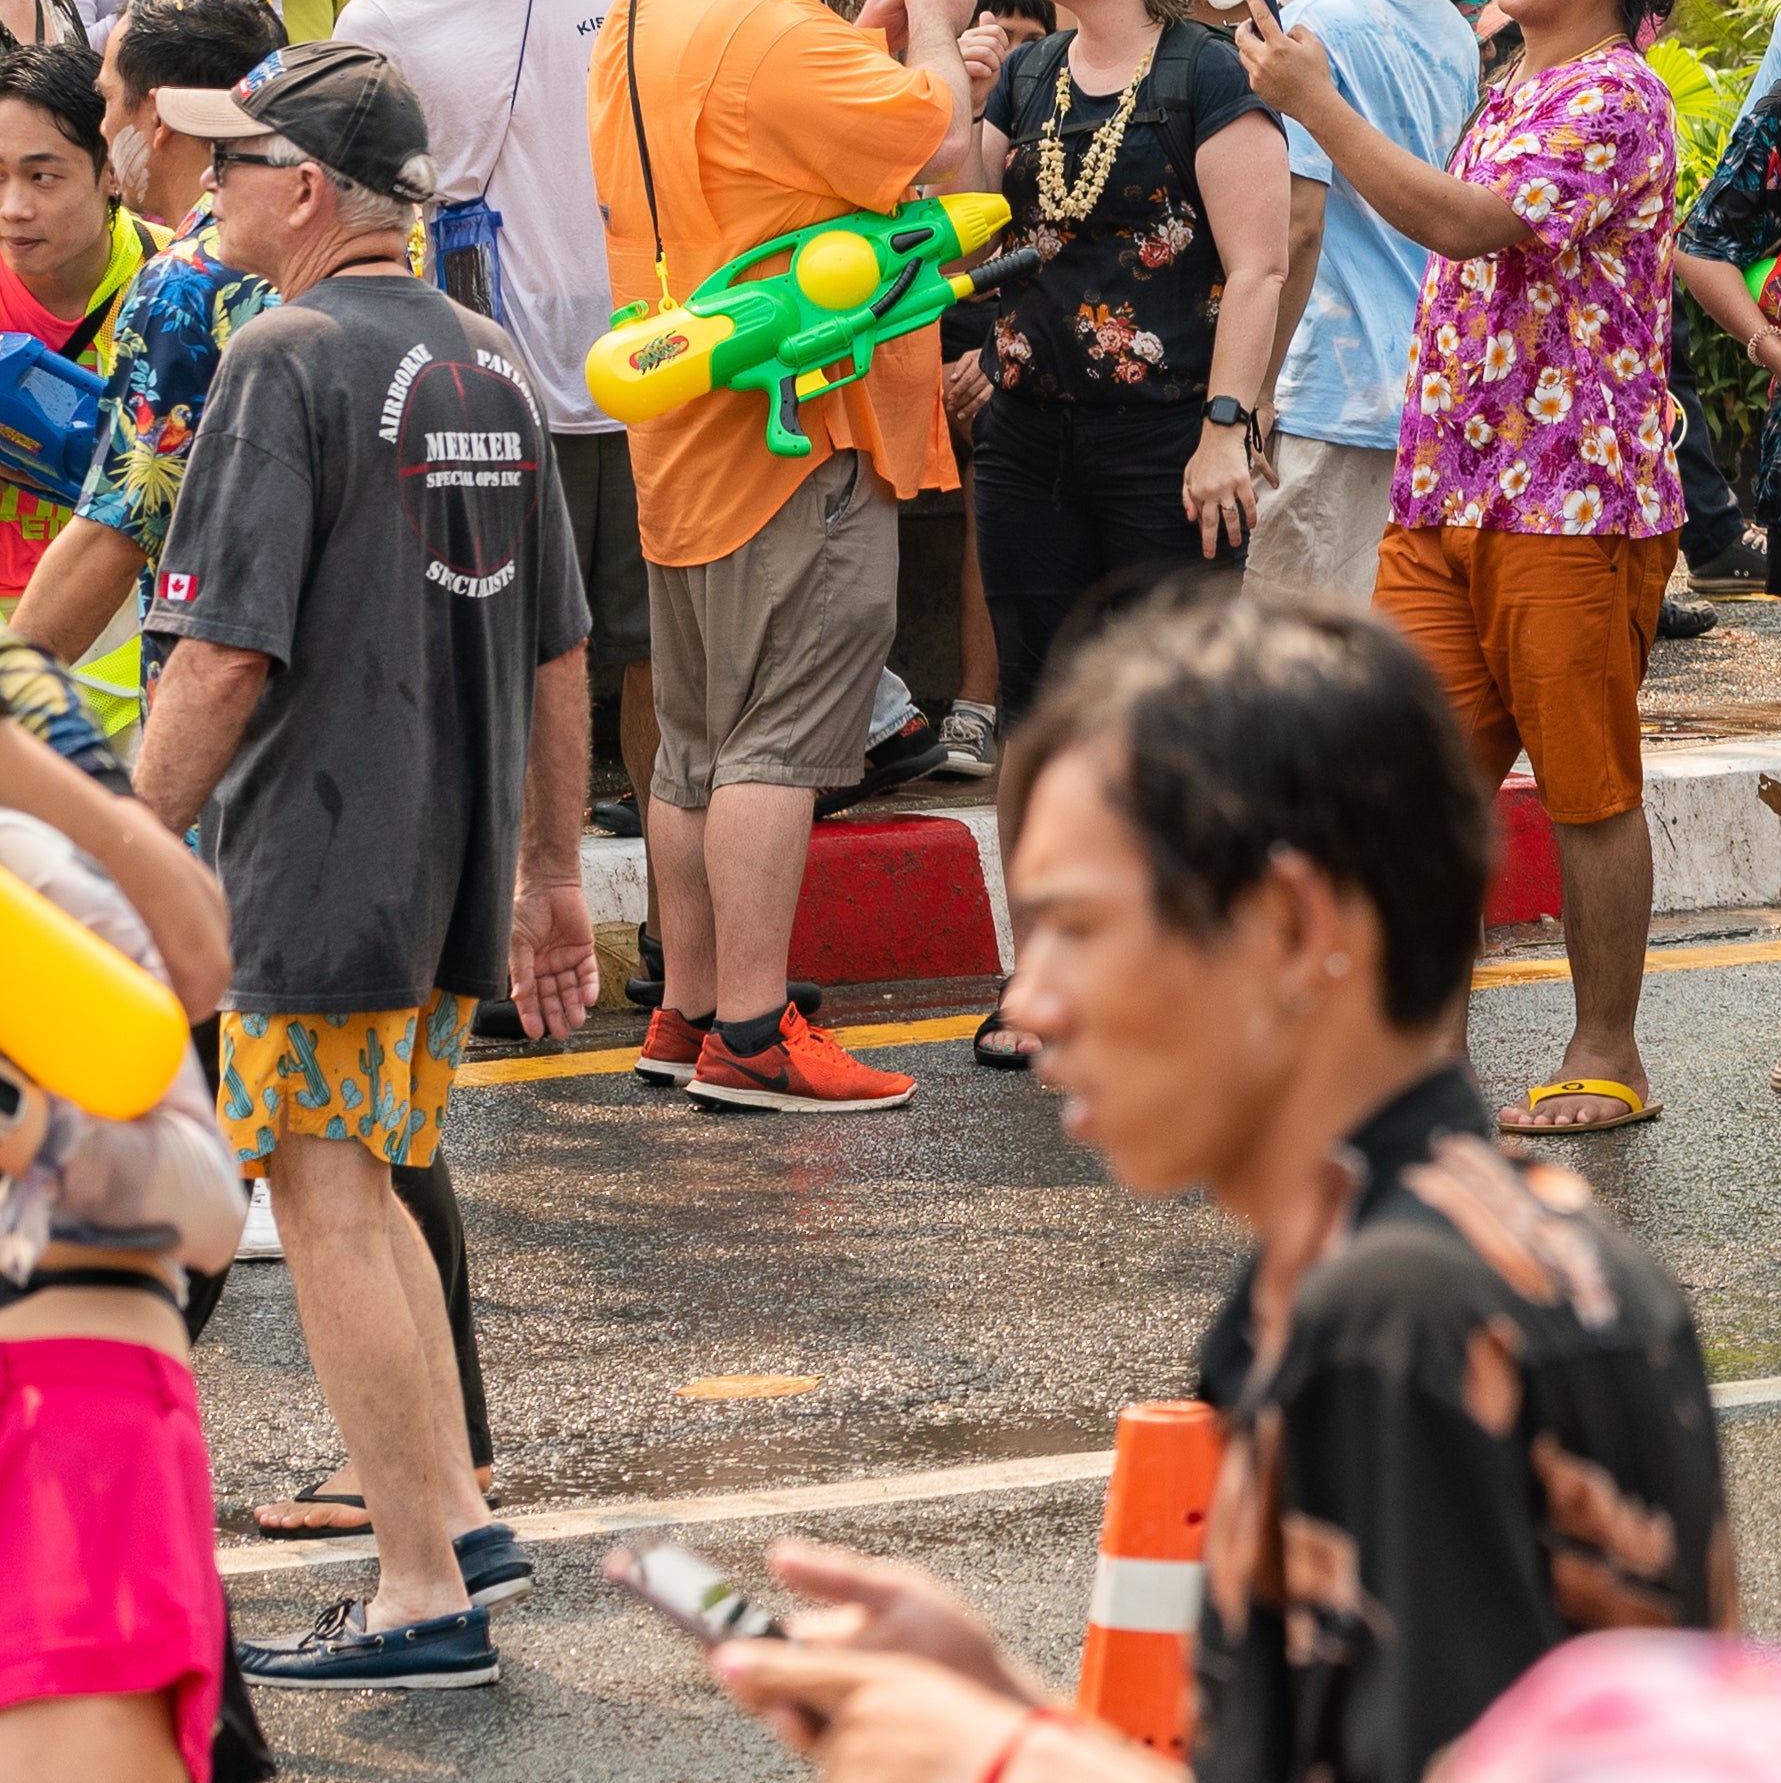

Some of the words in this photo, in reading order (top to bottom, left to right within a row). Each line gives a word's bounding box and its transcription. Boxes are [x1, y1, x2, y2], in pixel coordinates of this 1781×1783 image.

[378, 343, 433, 445] AIRBORNE
[424, 431, 522, 462] MEEKER
[426, 470, 474, 488] SPECIAL
[475, 470, 500, 487] OPS
[501, 470, 522, 487] INC
